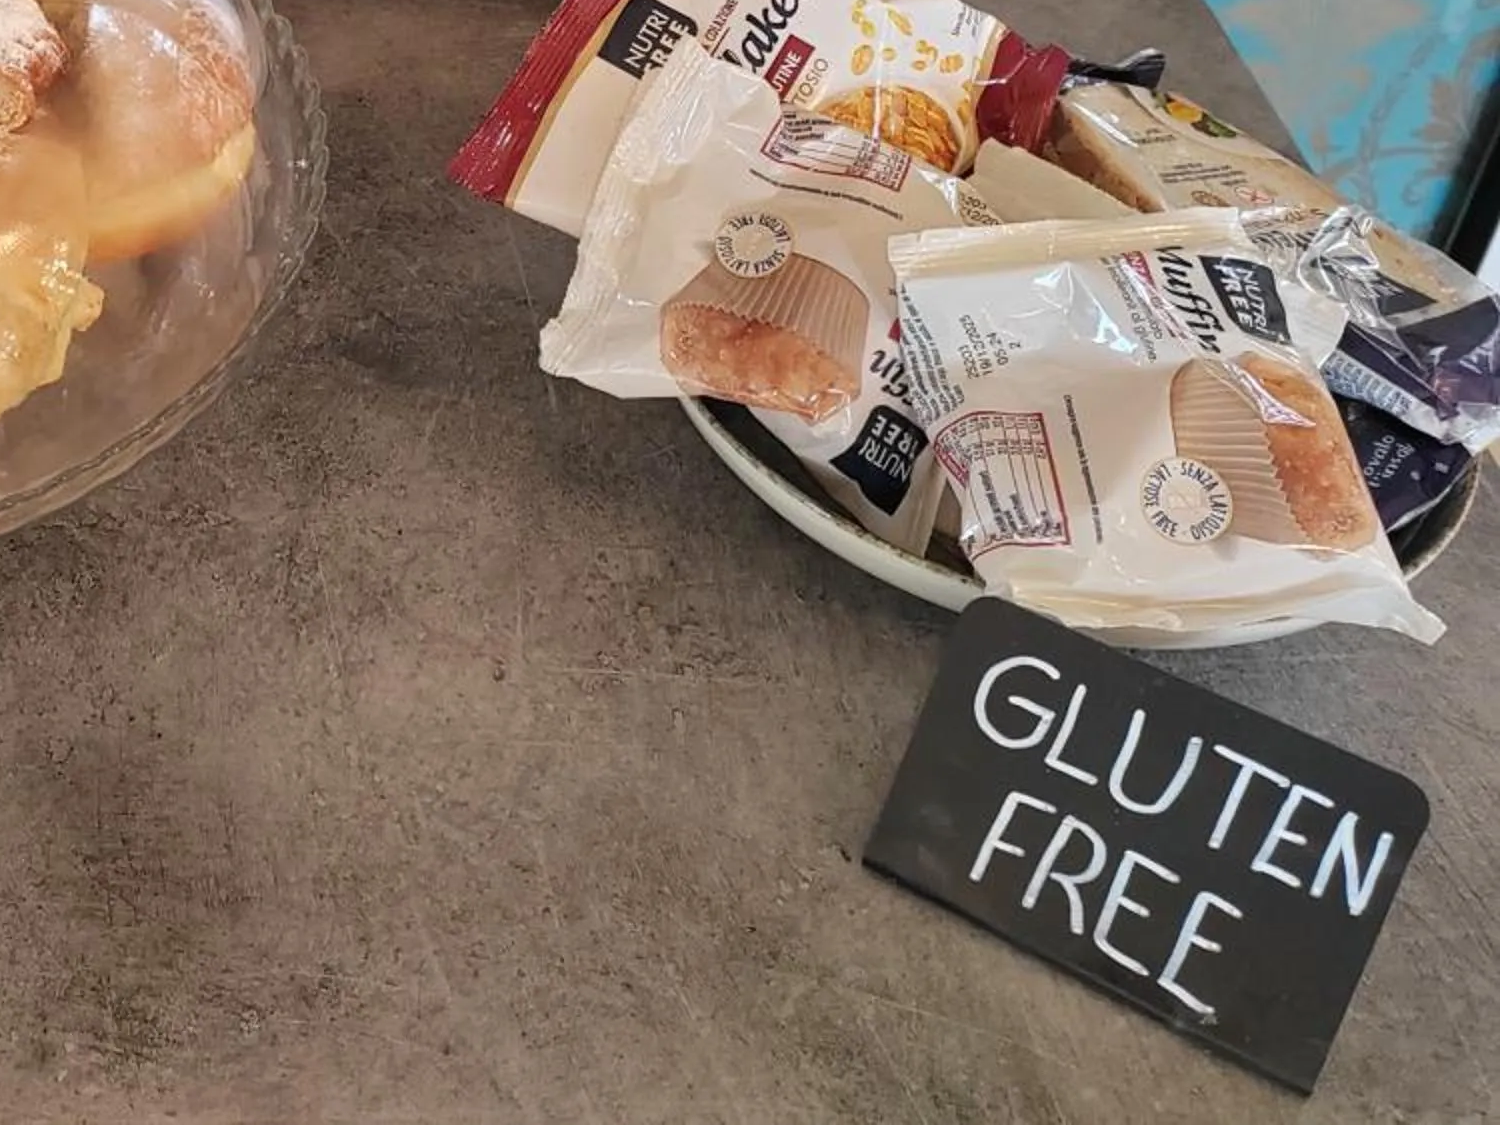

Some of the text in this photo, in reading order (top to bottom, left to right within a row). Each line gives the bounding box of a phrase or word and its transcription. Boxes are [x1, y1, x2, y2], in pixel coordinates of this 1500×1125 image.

[623, 8, 670, 70] NUTRI
[643, 17, 690, 77] REE
[770, 50, 803, 92] UTINE
[791, 57, 829, 105] TOSIO
[1155, 246, 1225, 354] Muffin
[1212, 262, 1255, 329] FREE
[1235, 266, 1269, 335] NUTRI
[857, 436, 912, 484] NUTRI
[1180, 461, 1220, 493] SENZA
[1363, 434, 1396, 477] ovato
[972, 655, 1395, 917] GLUTEN
[968, 790, 1244, 1016] FREE
